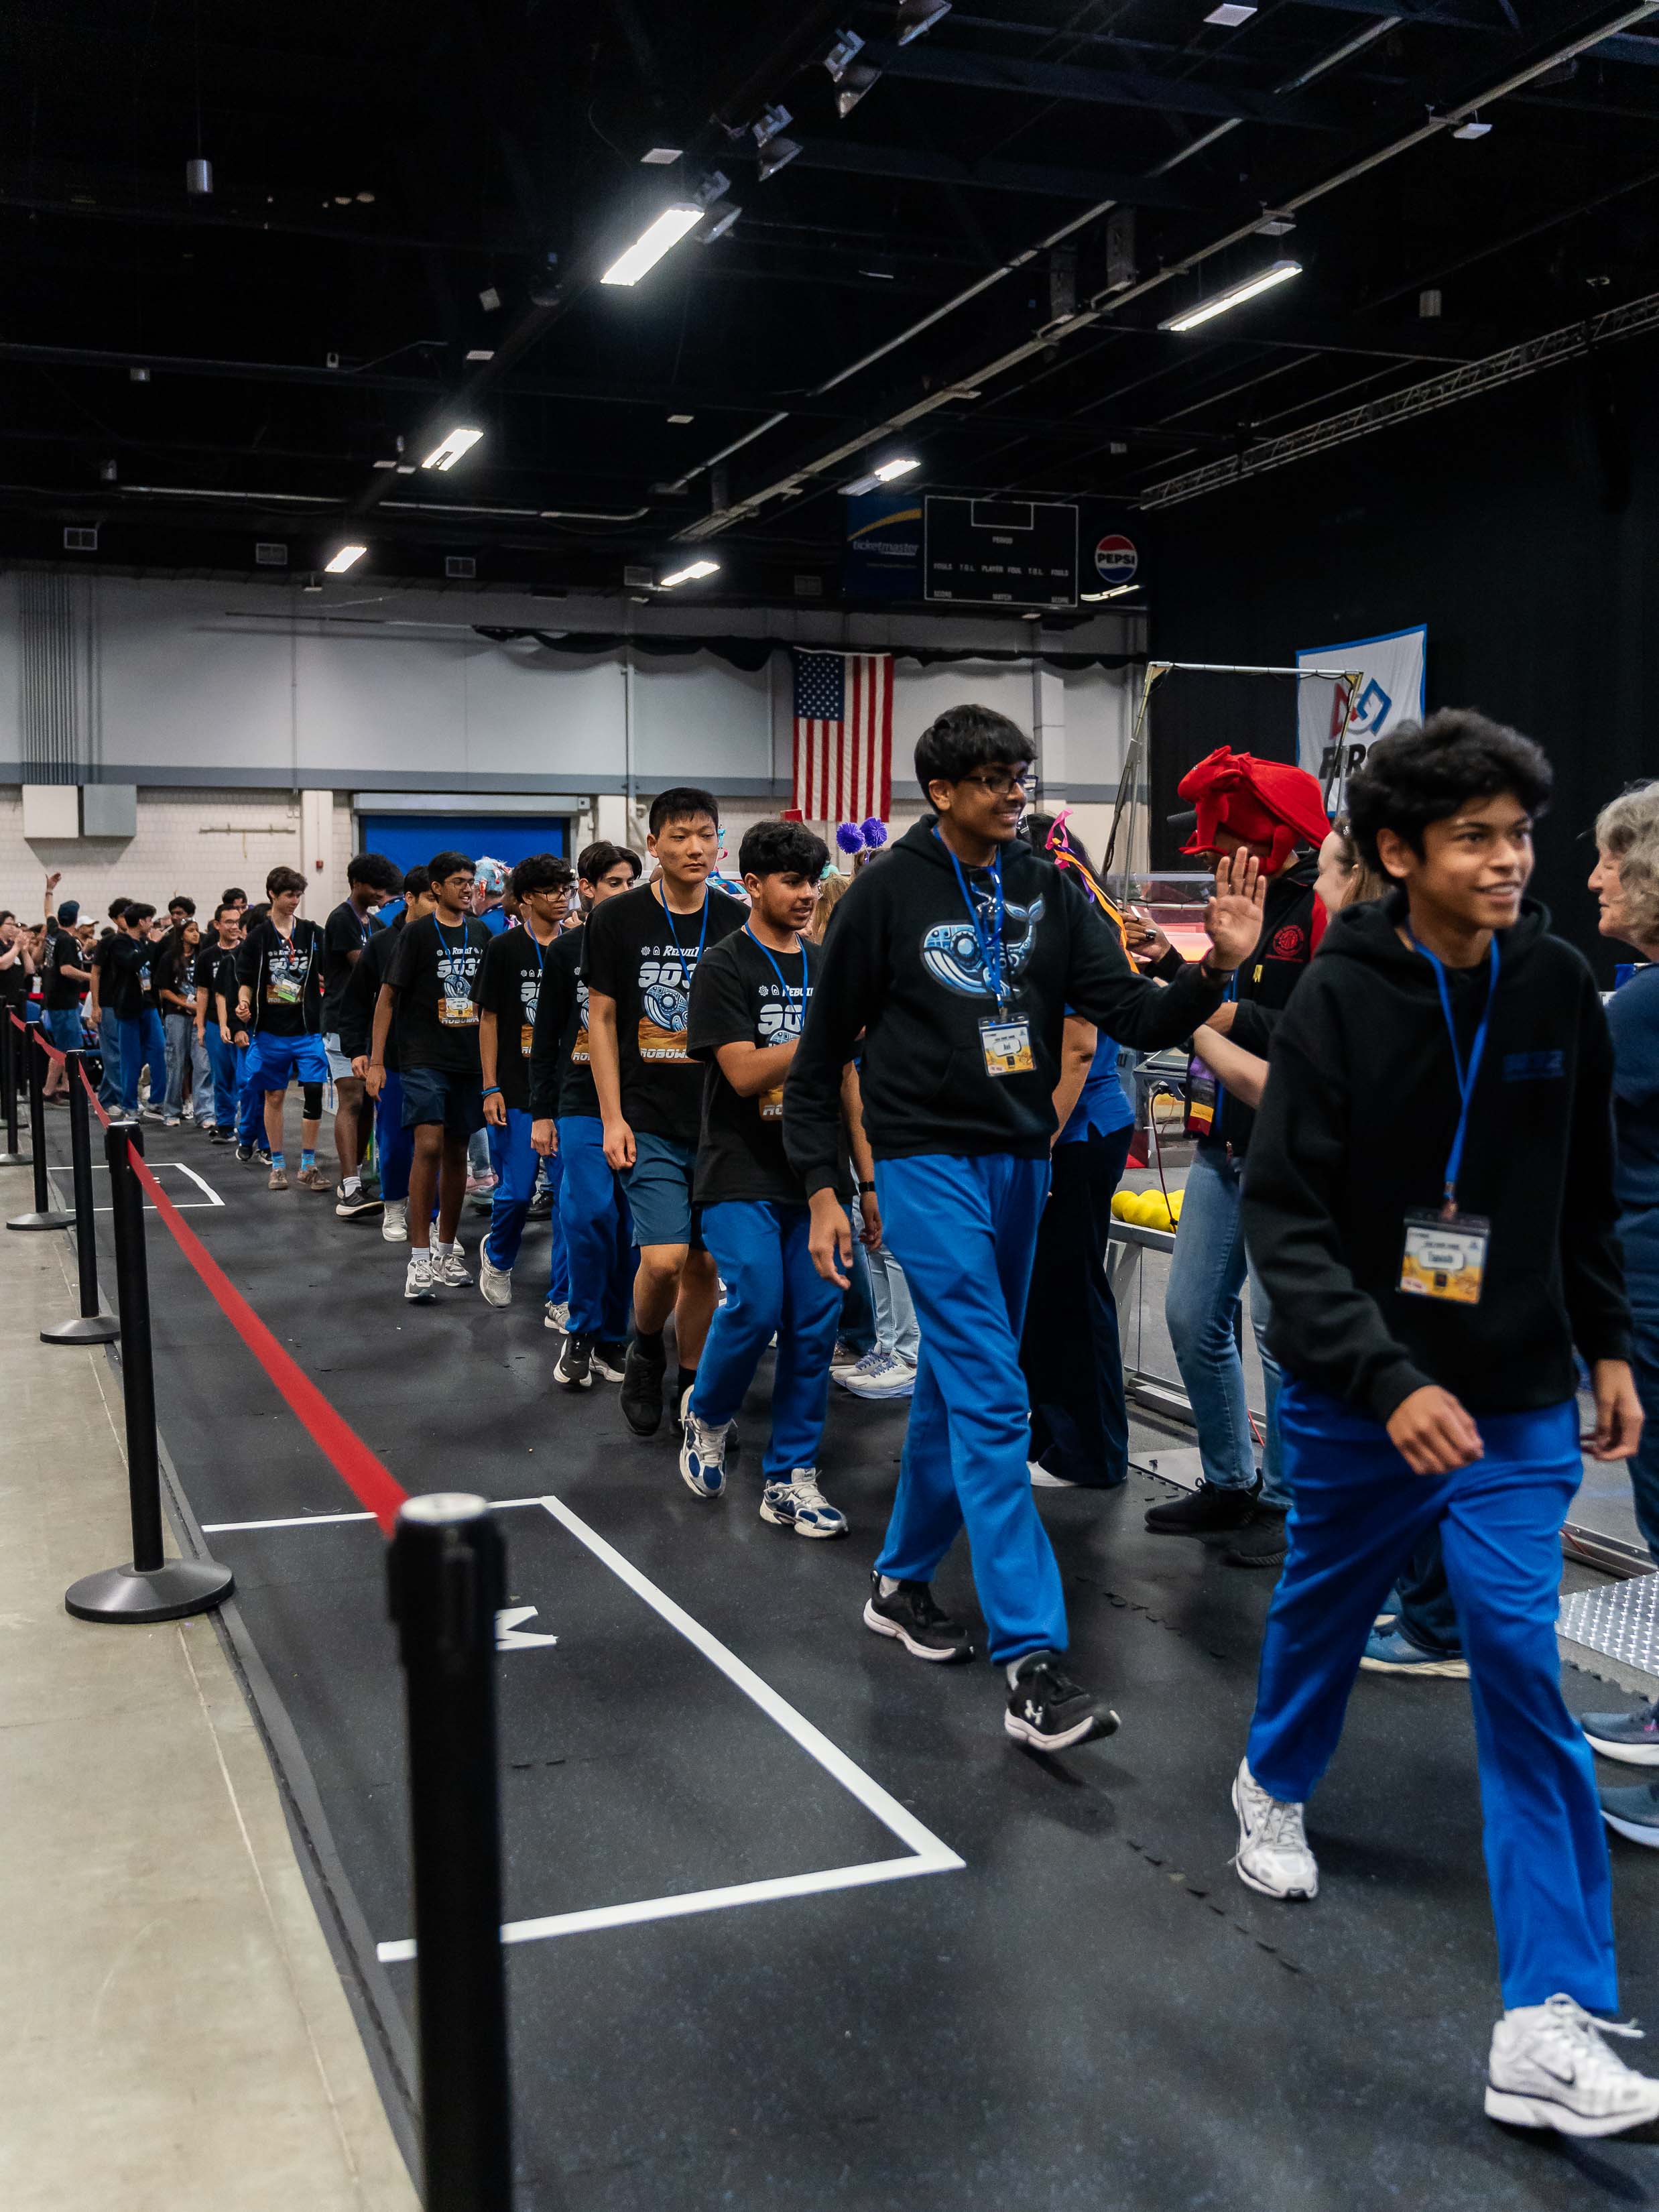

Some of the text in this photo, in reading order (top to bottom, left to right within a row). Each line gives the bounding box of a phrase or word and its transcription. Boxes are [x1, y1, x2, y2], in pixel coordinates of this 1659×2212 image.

[1097, 552, 1135, 565] PEPSI
[981, 565, 1003, 573] PLAYER
[1318, 743, 1374, 779] FIR
[269, 957, 308, 971] 9032
[641, 1048, 688, 1058] ROBOW
